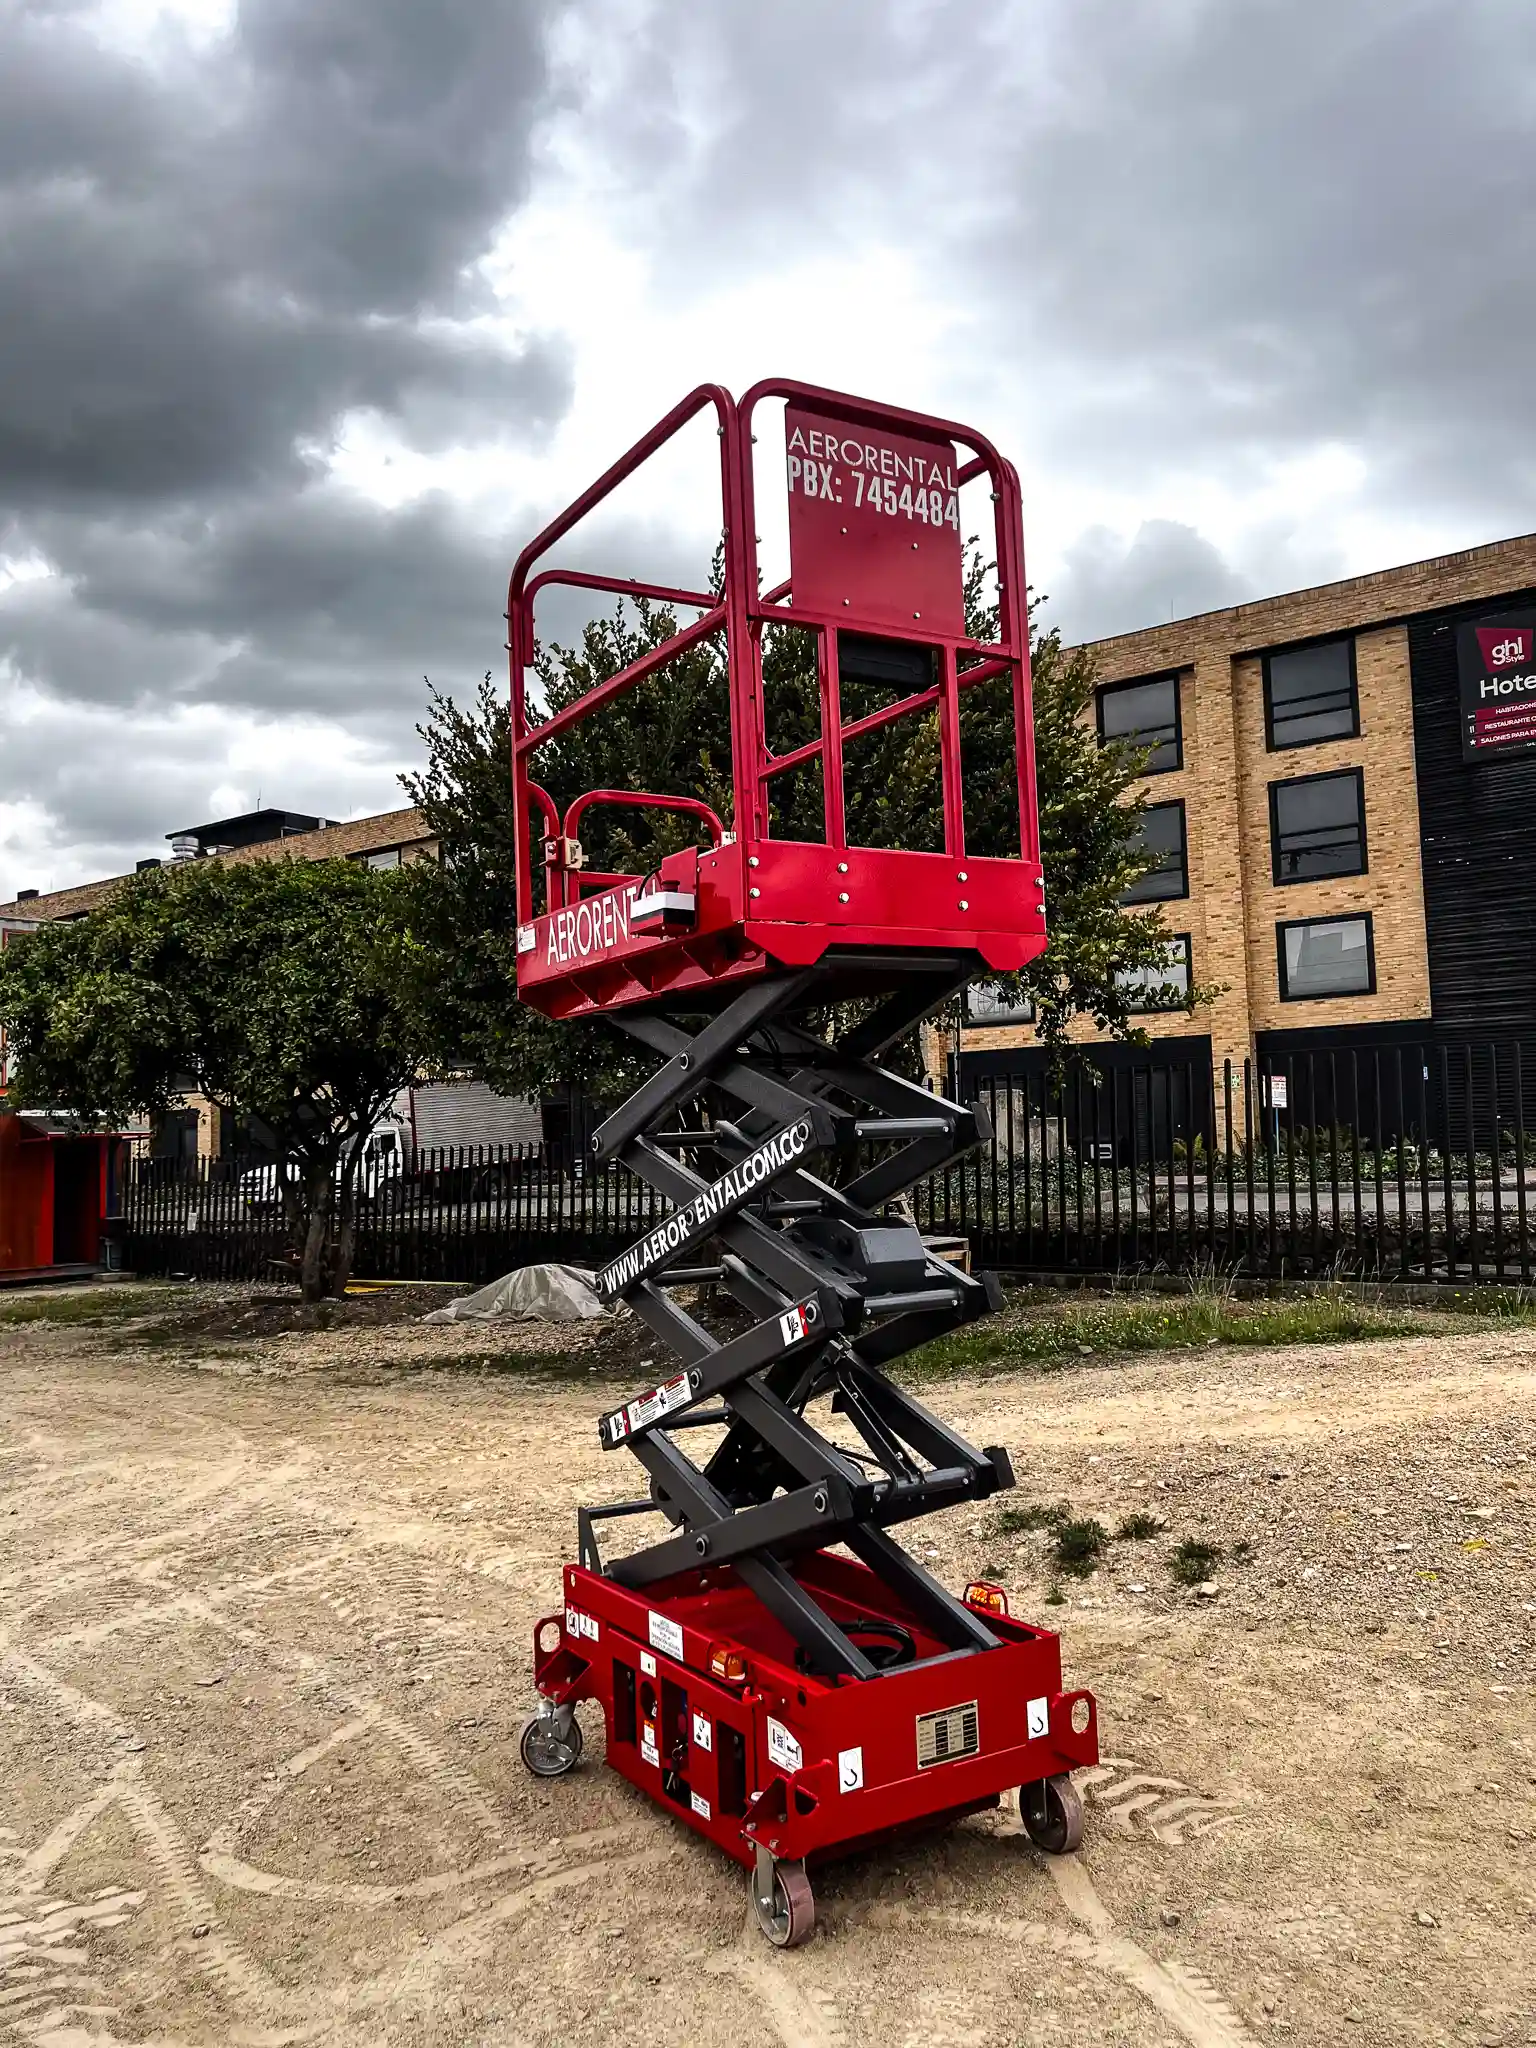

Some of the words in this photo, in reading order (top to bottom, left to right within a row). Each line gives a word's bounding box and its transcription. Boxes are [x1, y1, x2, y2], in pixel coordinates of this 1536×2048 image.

[788, 426, 959, 492] AERORENTAL
[788, 454, 842, 503] PBX:
[851, 470, 958, 530] 7454484
[1491, 636, 1523, 665] ghl
[1481, 734, 1511, 744] SALONES
[1511, 730, 1530, 738] PARA
[1485, 716, 1530, 730] RESTAURANTE
